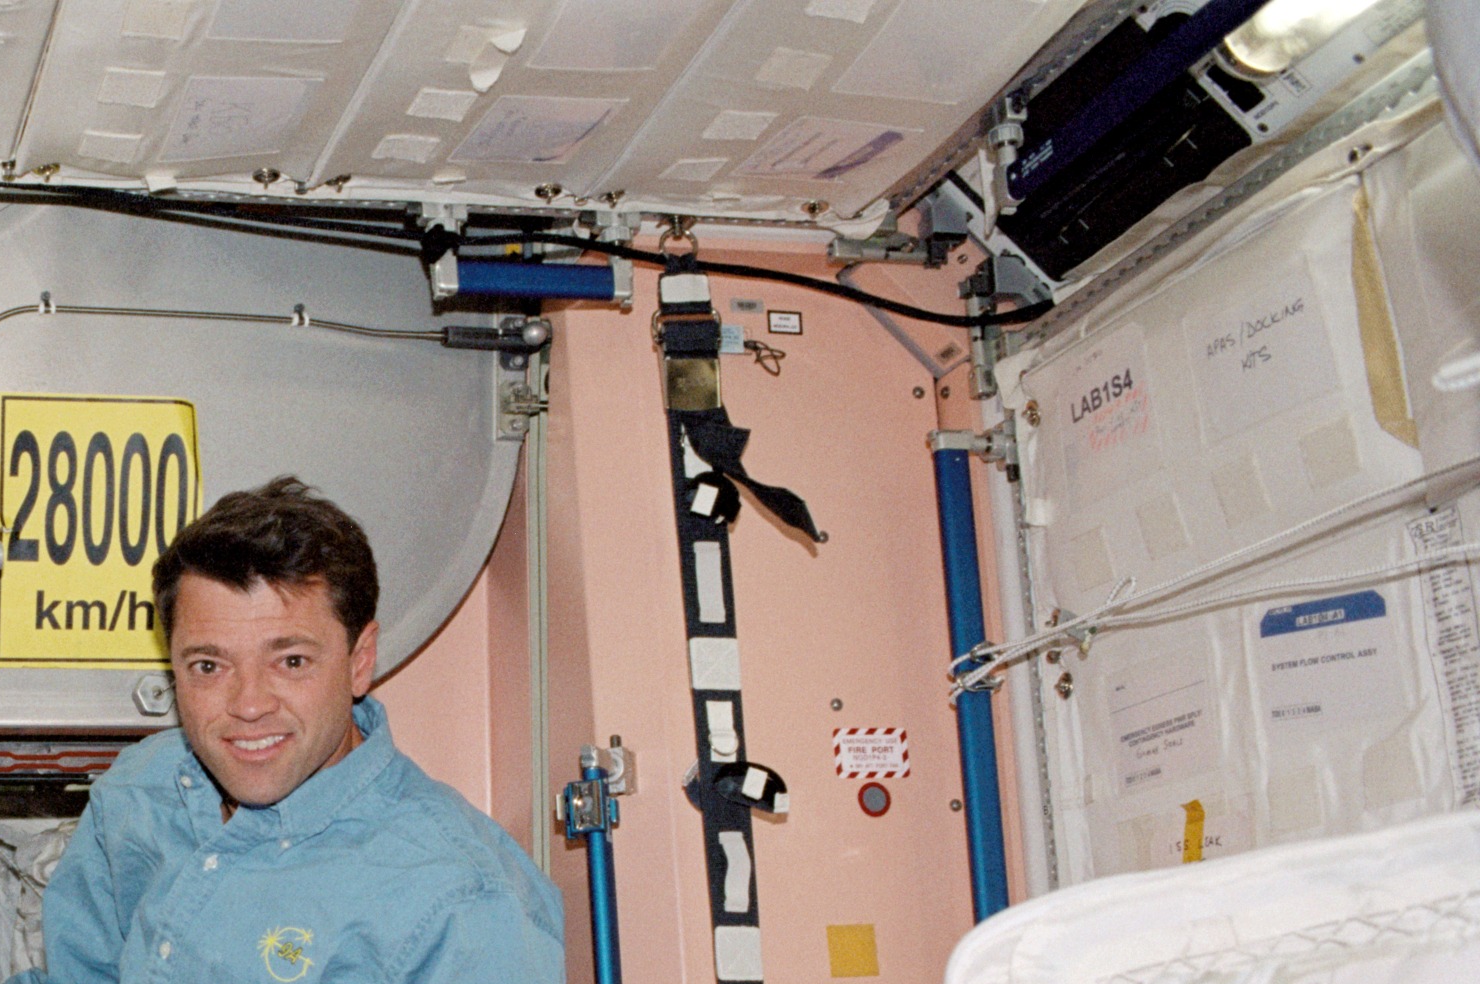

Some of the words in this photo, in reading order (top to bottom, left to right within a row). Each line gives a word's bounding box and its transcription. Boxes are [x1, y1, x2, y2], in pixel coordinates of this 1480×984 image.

[1071, 369, 1133, 423] LAB1S4
[7, 429, 188, 566] 28000
[35, 589, 154, 631] km/h
[1321, 652, 1355, 663] CONTROL
[278, 941, 302, 965] 9A
